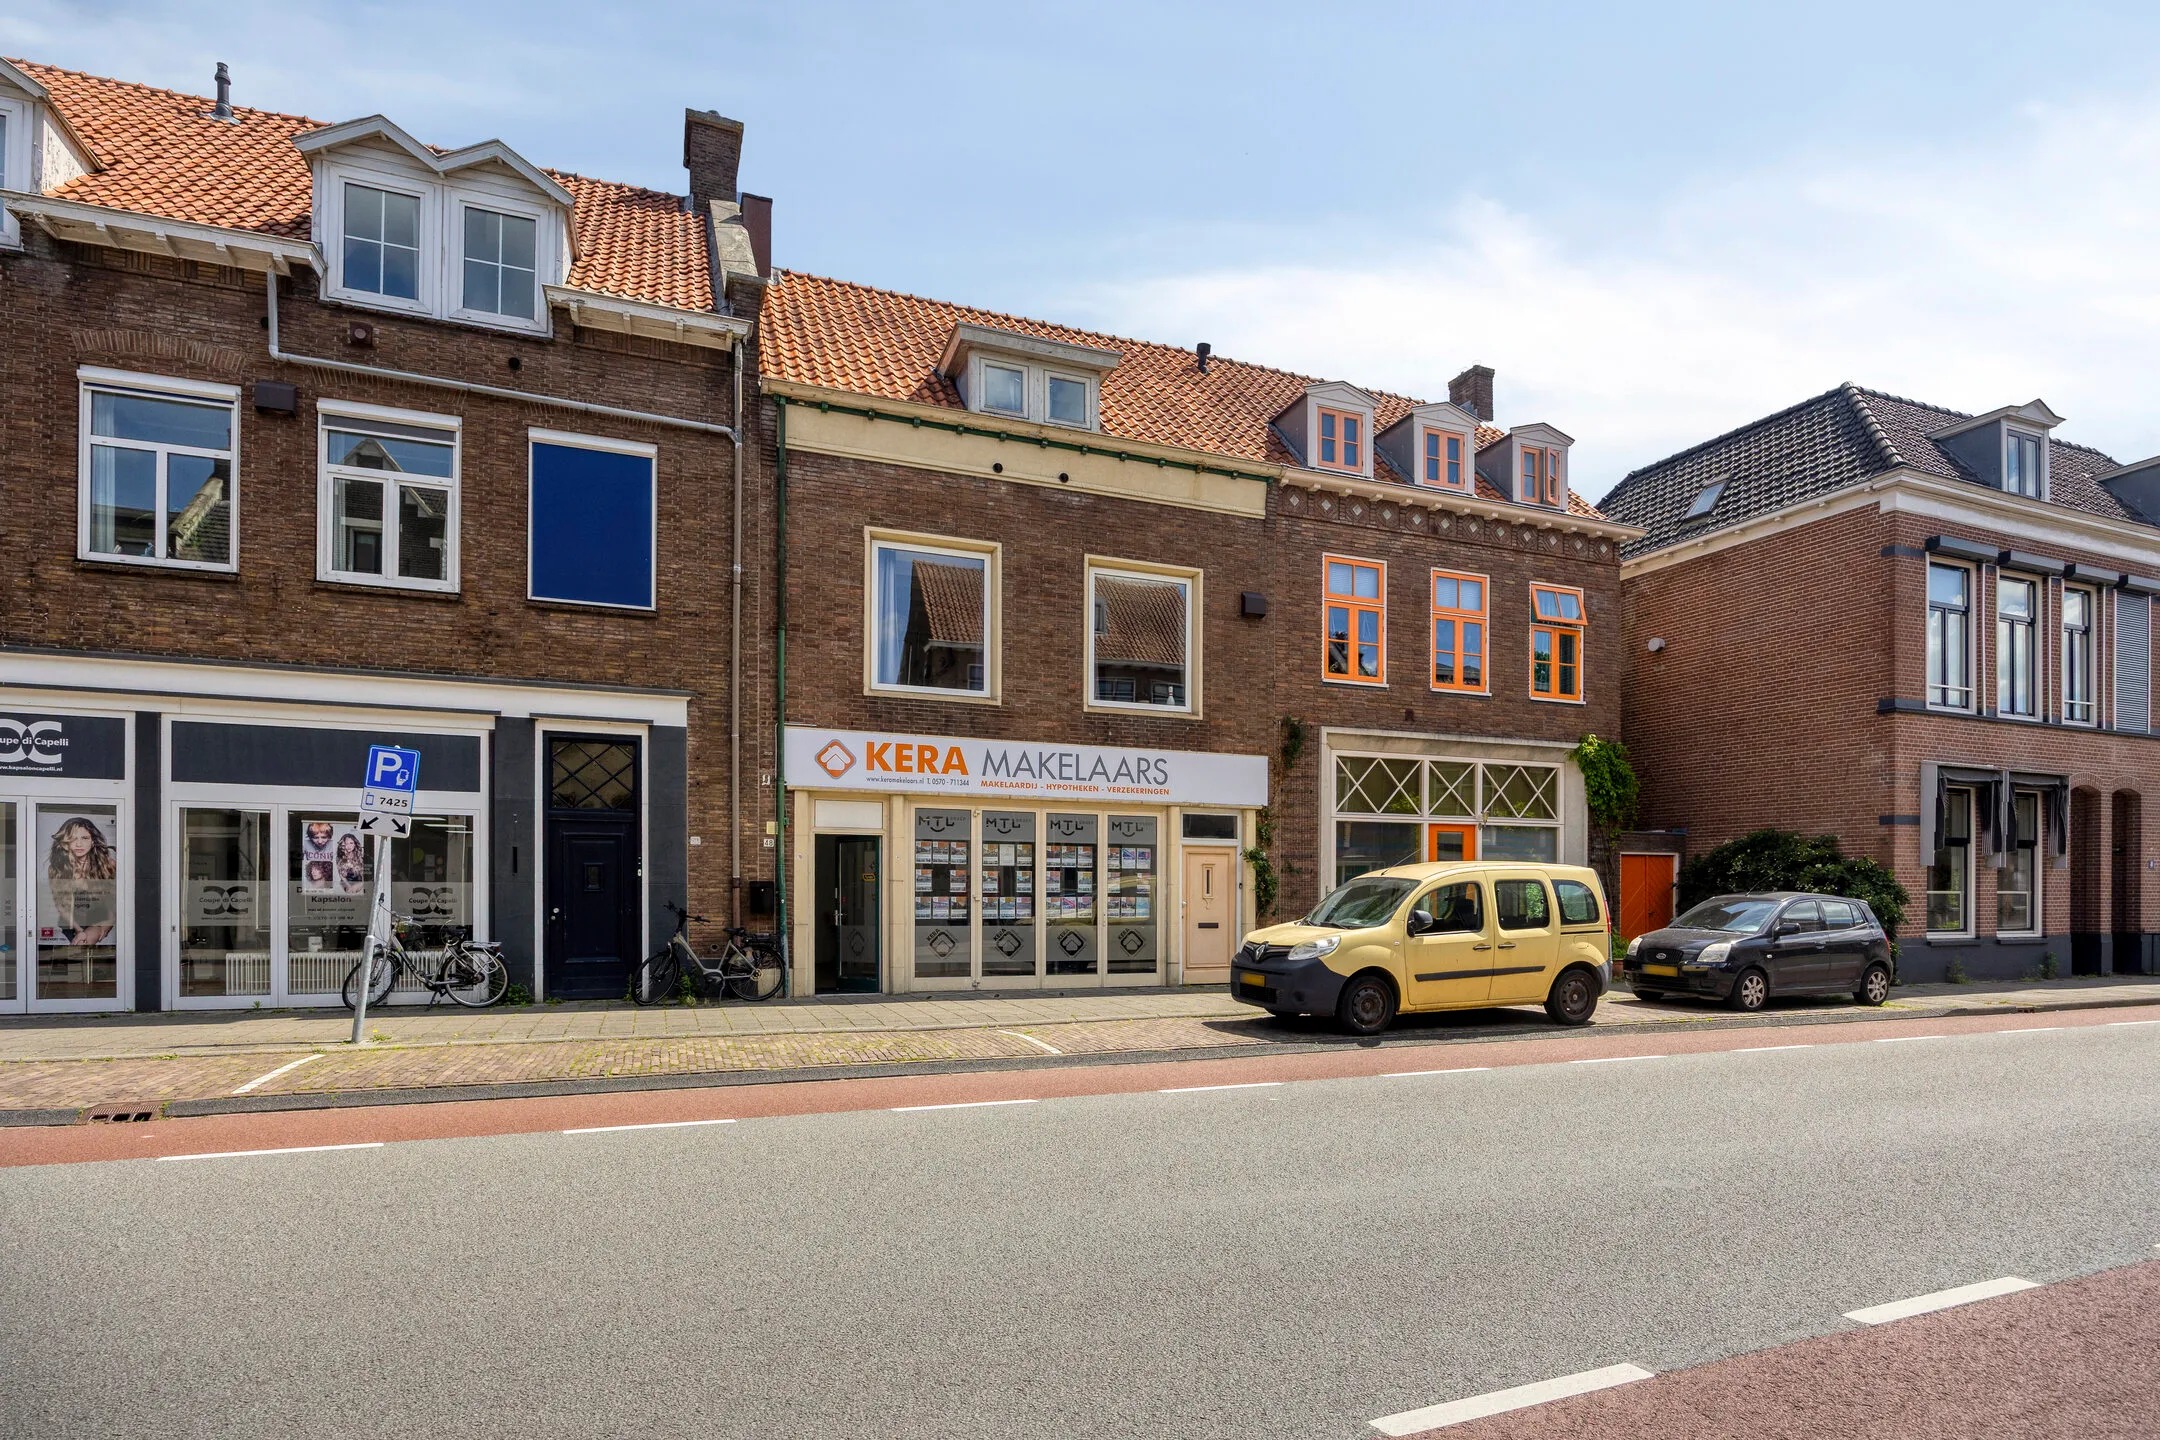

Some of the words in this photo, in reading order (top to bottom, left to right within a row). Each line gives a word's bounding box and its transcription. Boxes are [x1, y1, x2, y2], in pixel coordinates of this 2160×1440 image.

[22, 737, 32, 745] di
[34, 737, 69, 748] Capelli
[374, 751, 403, 782] P
[866, 741, 969, 776] KERA
[981, 747, 1168, 786] MAKELAARS
[866, 775, 924, 785] www.keramakelaars.nl
[931, 777, 946, 786] 0570
[950, 778, 970, 787] 711344
[980, 779, 1038, 790] MAKELAARDIJ
[1046, 783, 1099, 793] HYPOTHEKEN
[1106, 785, 1170, 796] VERZEKERINGEN
[380, 797, 408, 808] 7425
[918, 815, 955, 827] MTL
[986, 817, 1021, 829] MTL
[1050, 819, 1084, 831] MTL
[1112, 821, 1144, 833] MTL
[764, 839, 775, 847] 48
[199, 896, 221, 904] Coupe
[311, 895, 352, 904] Kapsalon
